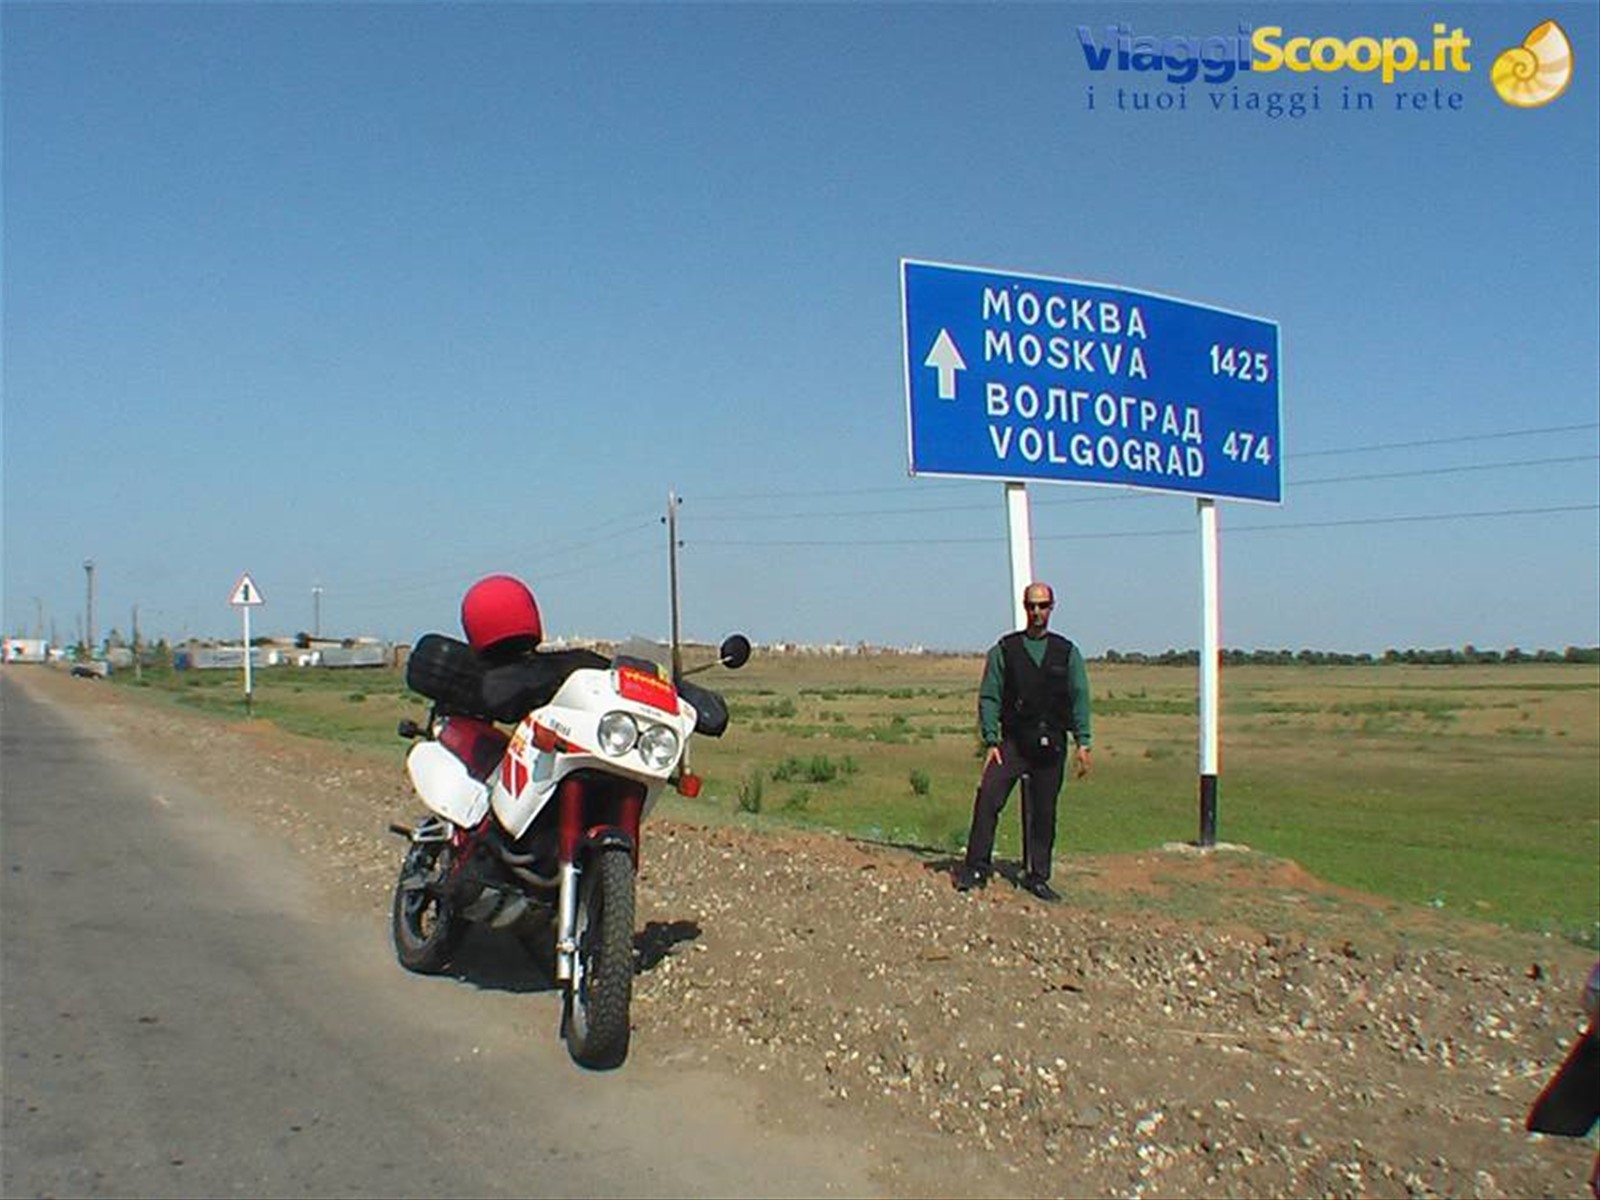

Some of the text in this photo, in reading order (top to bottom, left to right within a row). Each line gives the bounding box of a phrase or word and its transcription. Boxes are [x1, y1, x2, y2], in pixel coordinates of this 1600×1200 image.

[982, 287, 1147, 339] МОСКВА
[984, 330, 1147, 379] MOSKVA
[1209, 344, 1269, 382] 1425
[986, 383, 1202, 444] ВОЛГОГРАД
[989, 426, 1204, 477] VOLGOGRAD
[1222, 431, 1271, 465] 474
